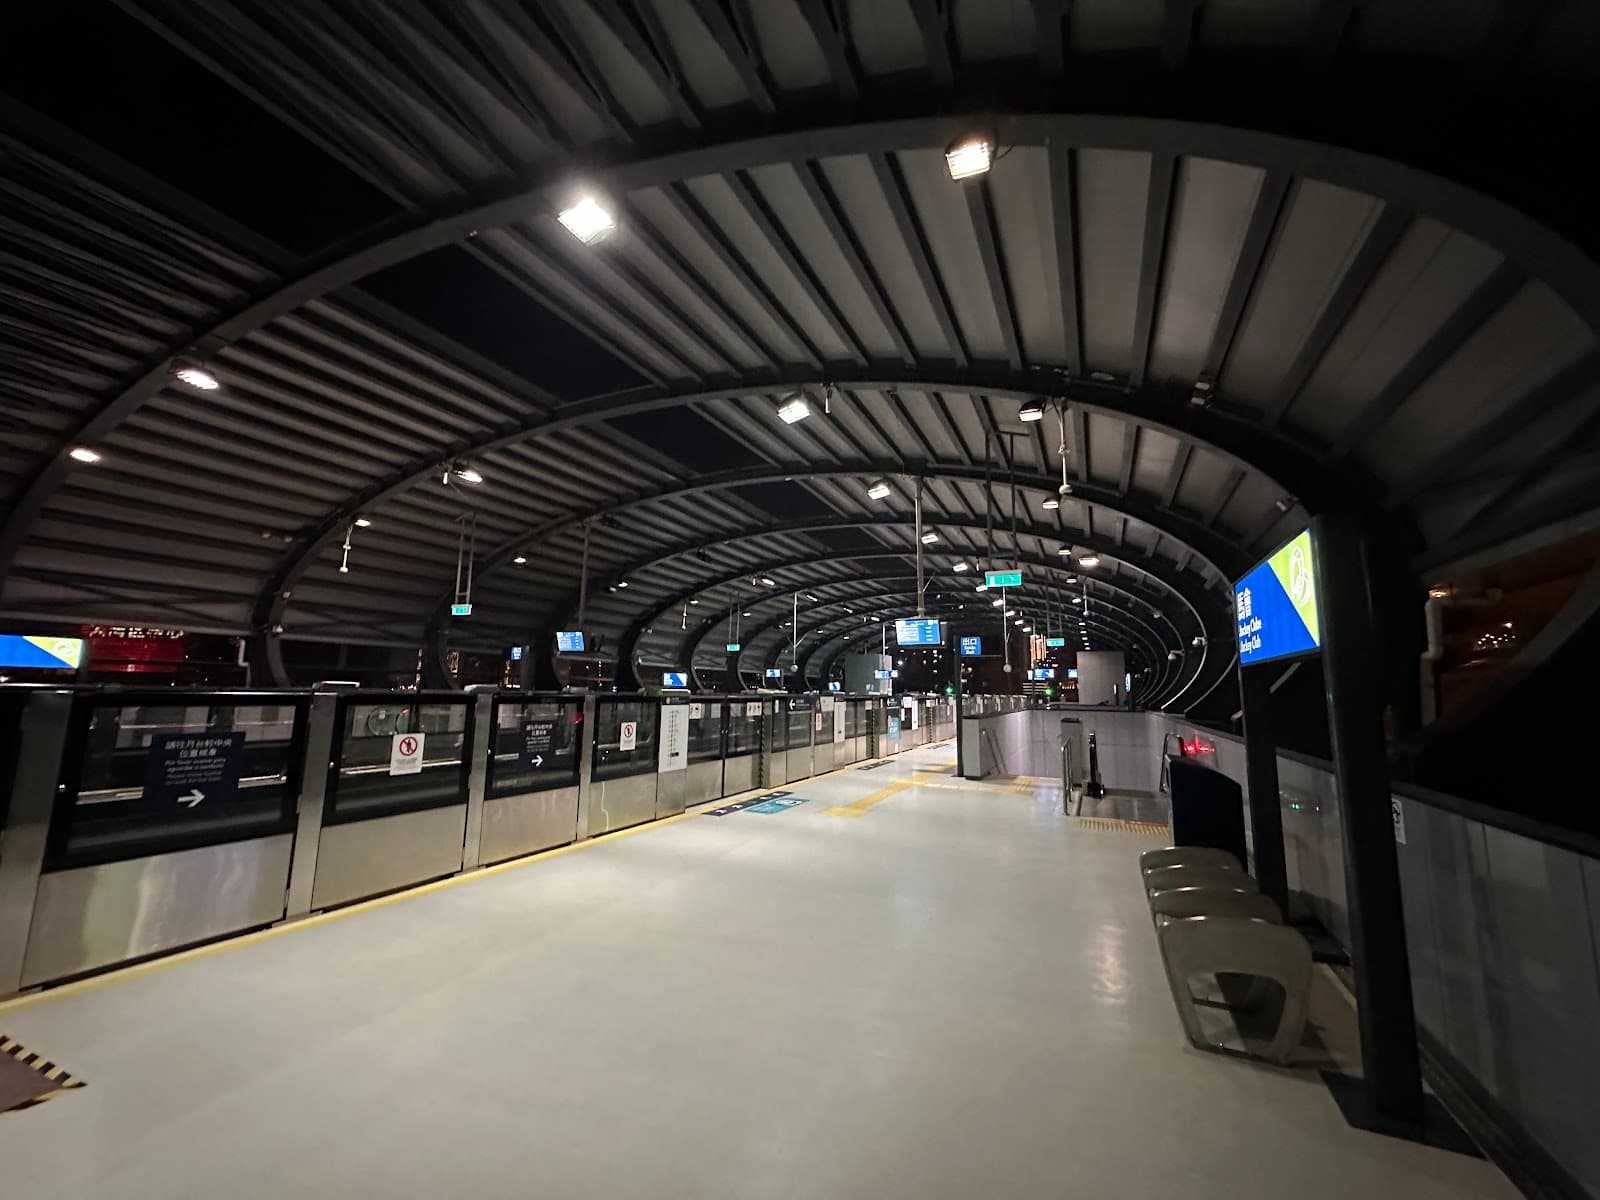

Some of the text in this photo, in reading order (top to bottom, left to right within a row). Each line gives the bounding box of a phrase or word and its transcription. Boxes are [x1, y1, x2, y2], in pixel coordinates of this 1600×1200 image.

[1239, 617, 1262, 637] Jockey Clube
[1240, 634, 1261, 654] Jockey Club
